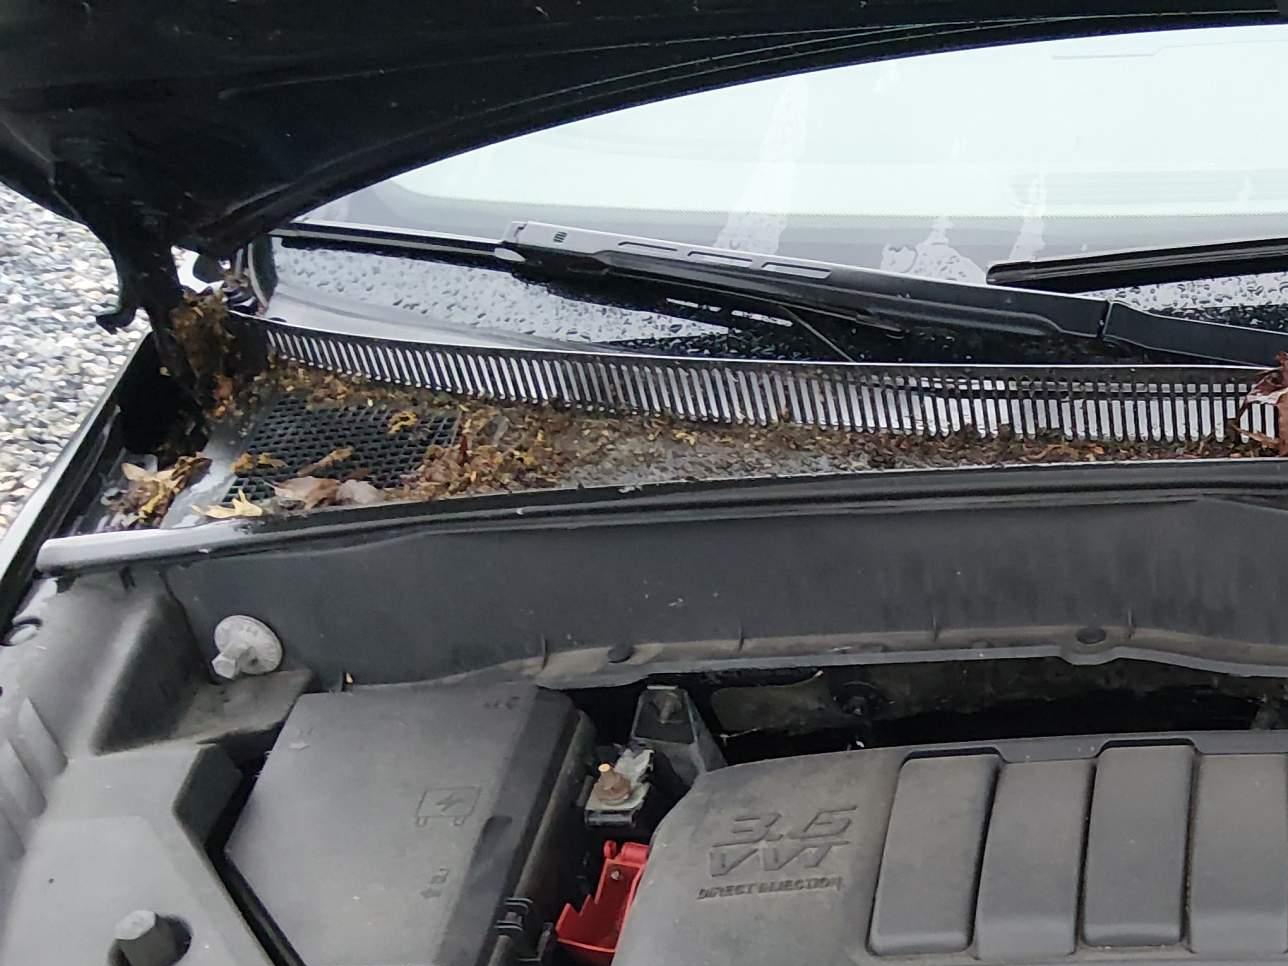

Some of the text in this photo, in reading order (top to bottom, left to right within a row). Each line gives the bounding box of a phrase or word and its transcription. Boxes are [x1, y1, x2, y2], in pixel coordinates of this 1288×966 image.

[712, 804, 858, 849] 3.6
[709, 840, 851, 878] VVT
[697, 882, 757, 900] DIRECT
